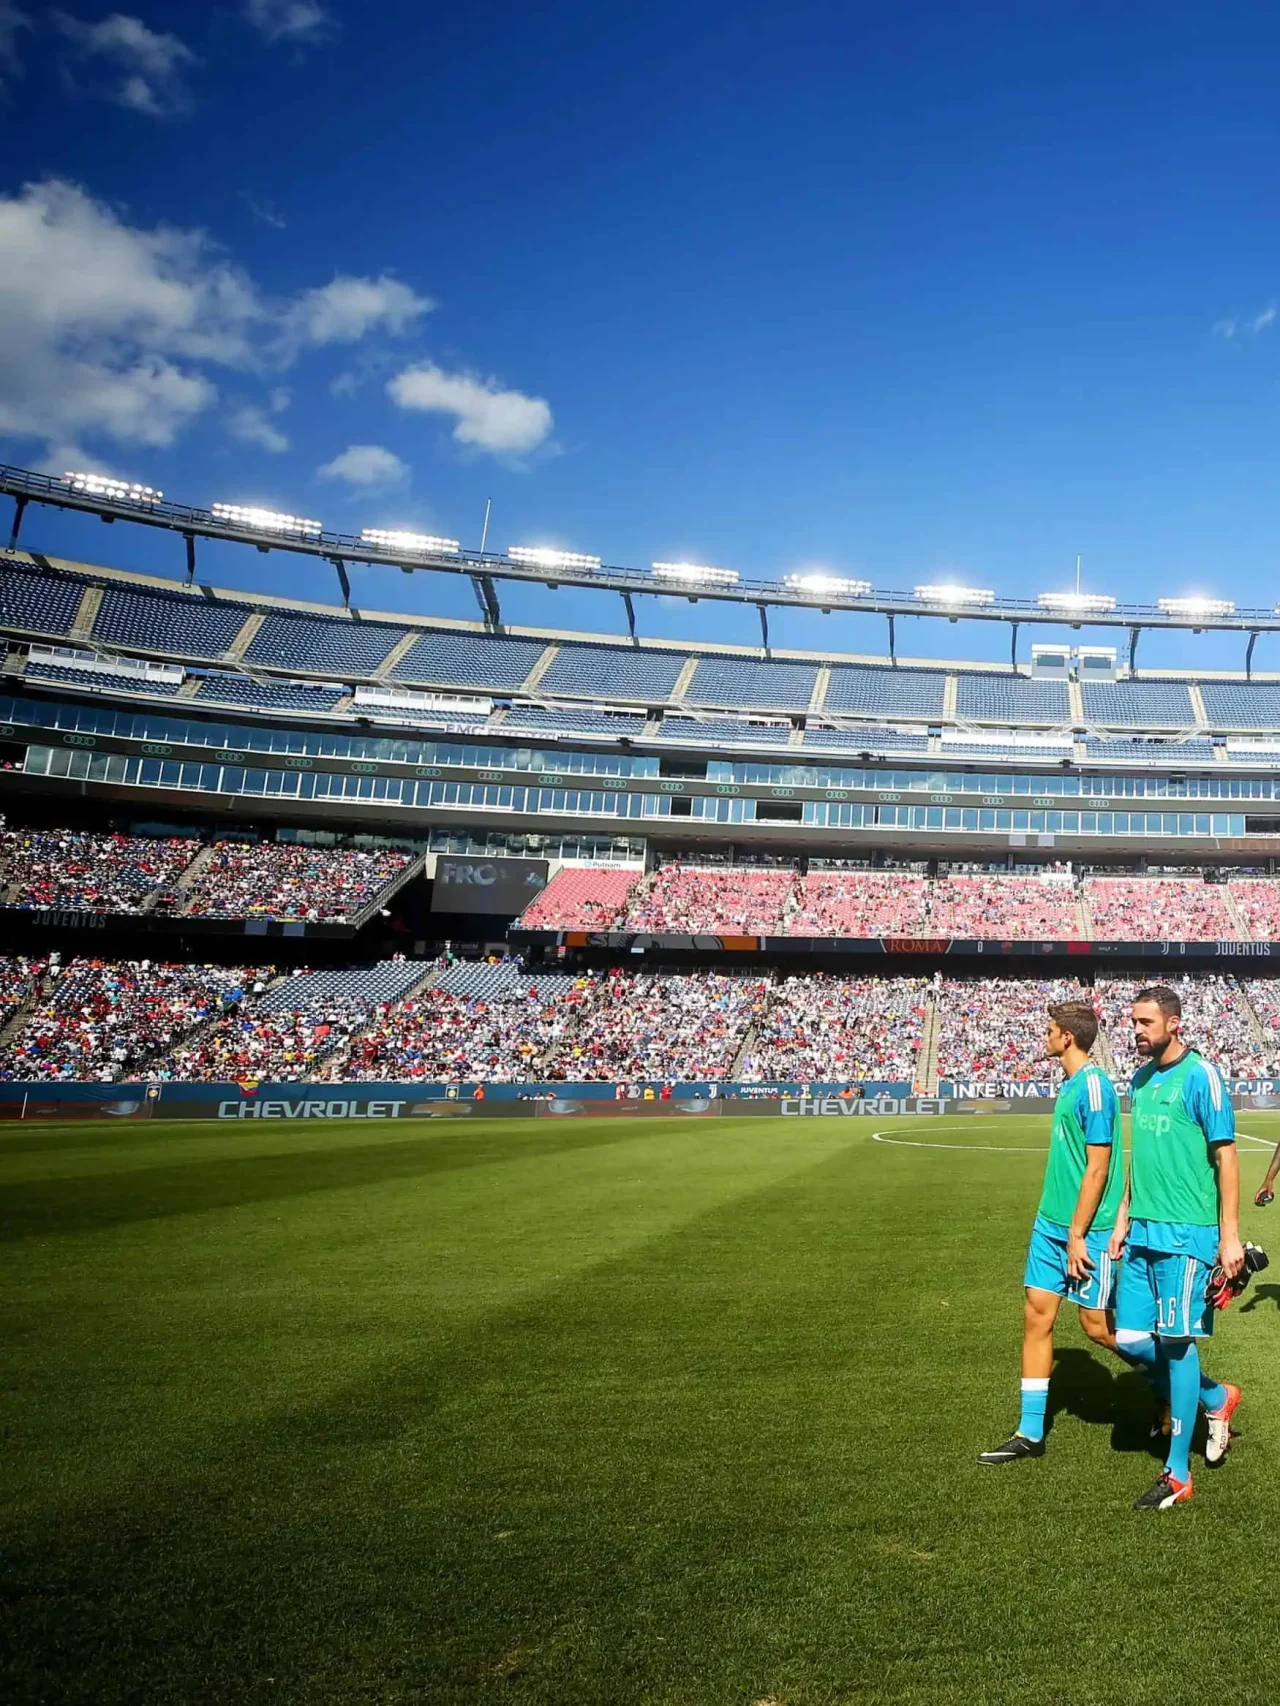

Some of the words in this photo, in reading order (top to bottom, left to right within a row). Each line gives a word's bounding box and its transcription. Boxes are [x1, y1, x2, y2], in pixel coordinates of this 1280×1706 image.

[32, 911, 106, 928] JUVENTUS
[889, 940, 942, 952] ROMA
[1215, 943, 1271, 956] JUVENTUS
[1235, 1081, 1274, 1096] CUP
[218, 1101, 406, 1118] CHEVROLET
[781, 1099, 950, 1116] CHEVROLET
[1156, 1297, 1176, 1327] 16
